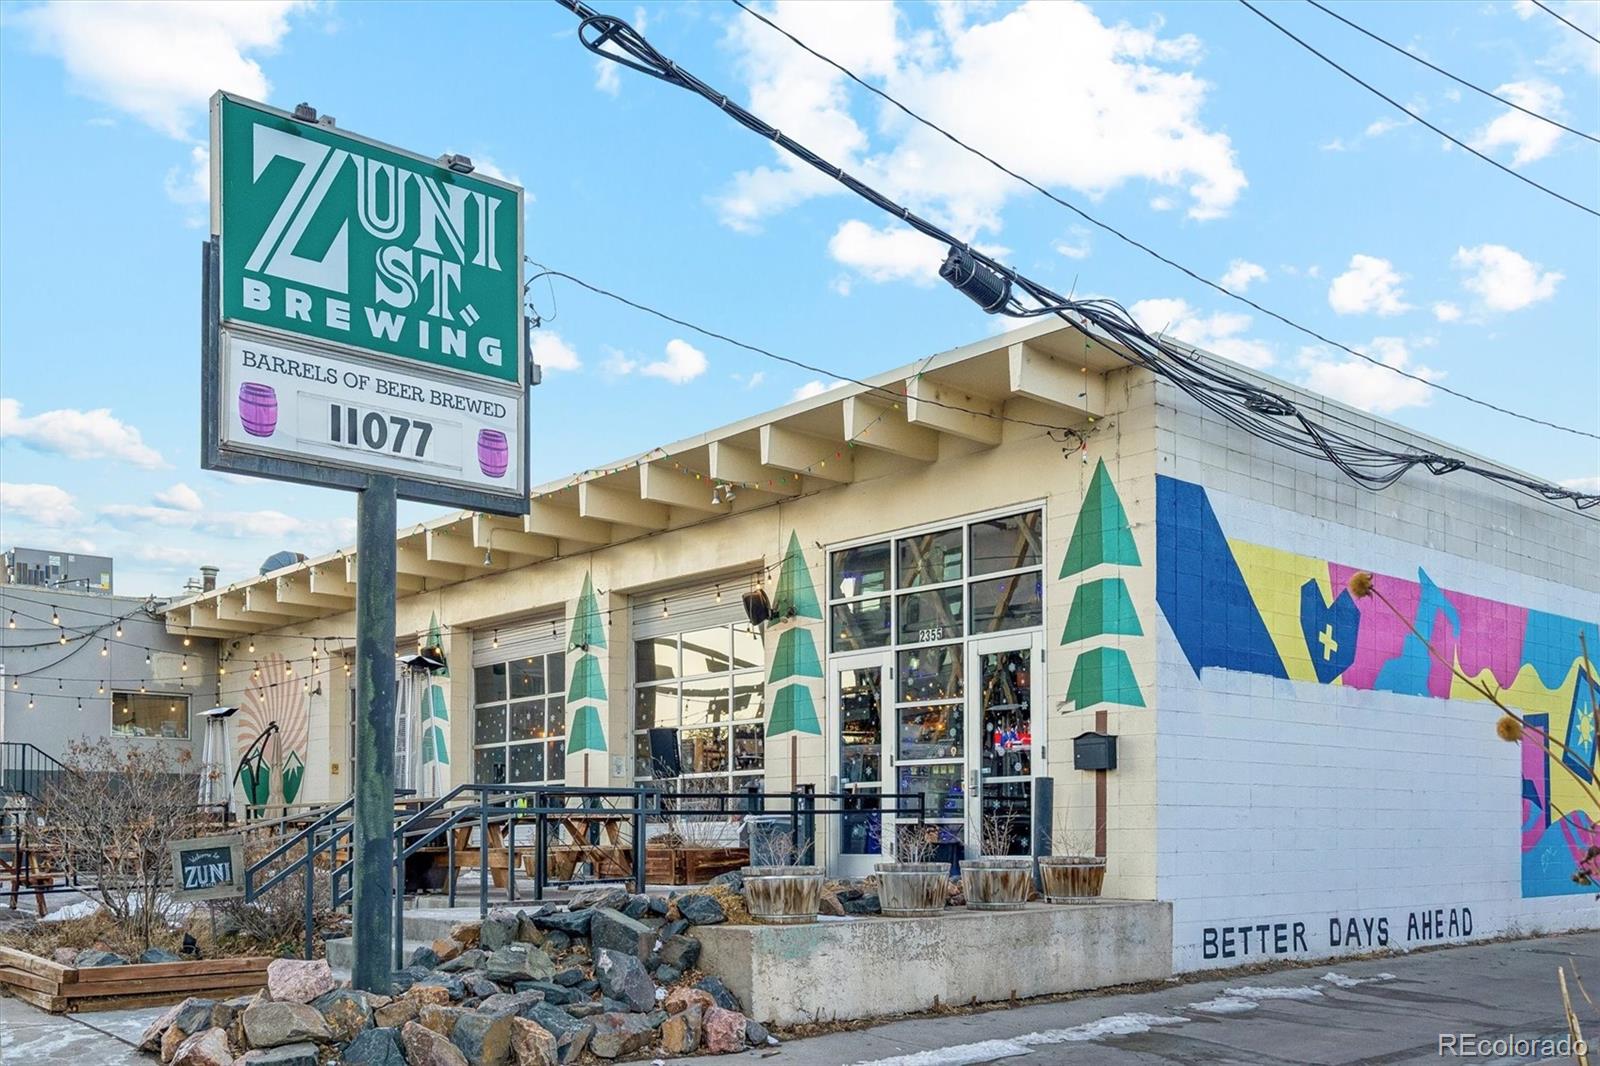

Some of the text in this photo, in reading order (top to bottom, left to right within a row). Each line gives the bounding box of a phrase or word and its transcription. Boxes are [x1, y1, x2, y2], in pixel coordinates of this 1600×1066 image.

[245, 122, 502, 294] ZUNI
[243, 276, 502, 366] BREWING
[242, 350, 507, 418] BARRELS OF BEER BREWED
[330, 404, 433, 457] 11077
[919, 629, 942, 642] 2355
[184, 862, 231, 888] ZUNI
[1203, 907, 1473, 959] BETTER DAYS AHEAD
